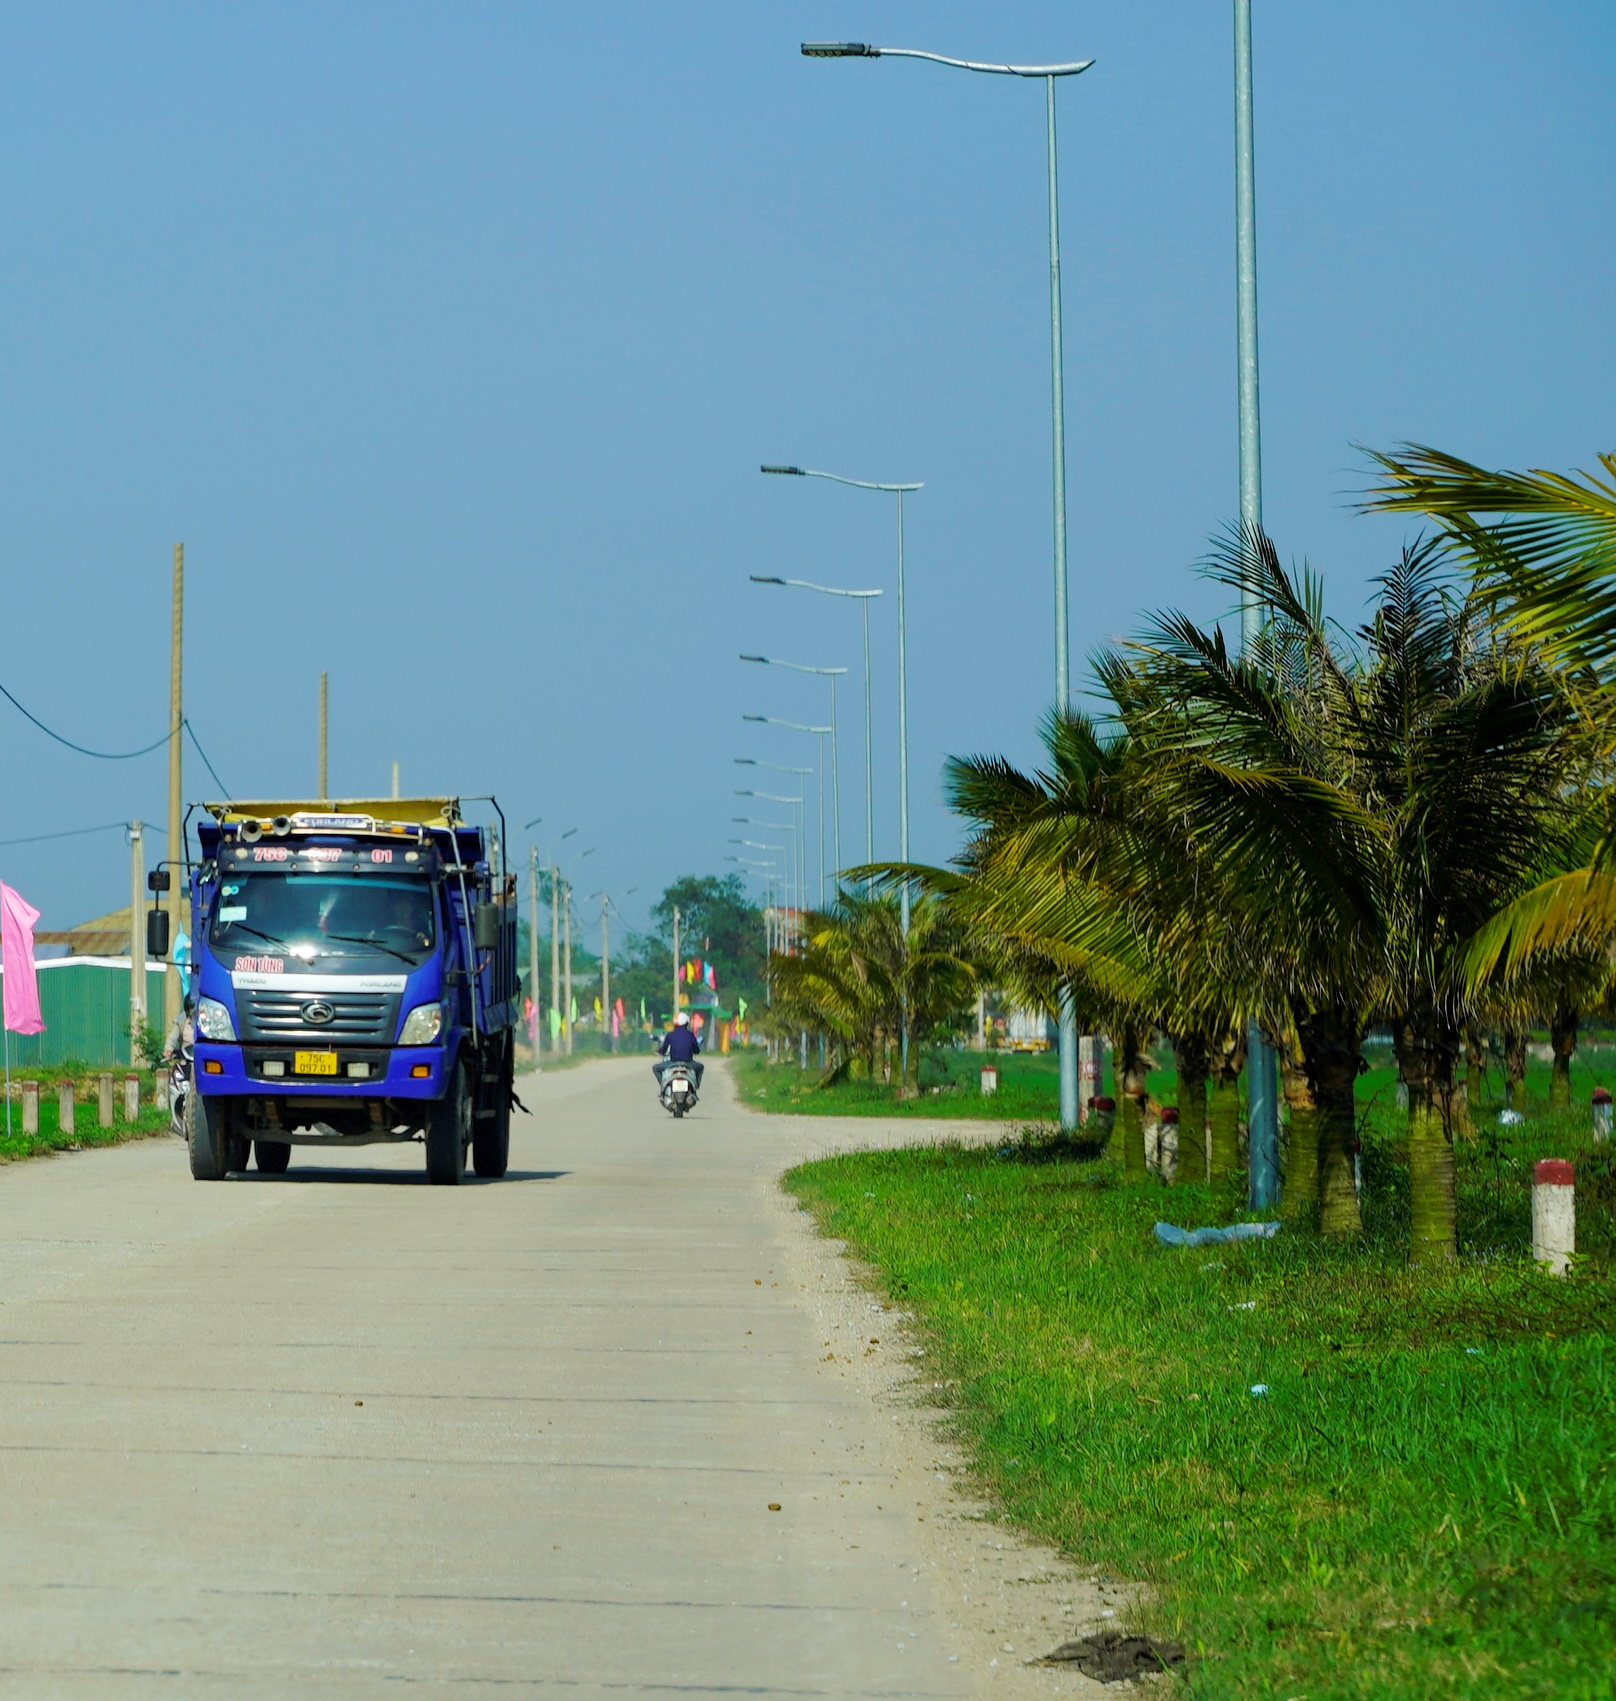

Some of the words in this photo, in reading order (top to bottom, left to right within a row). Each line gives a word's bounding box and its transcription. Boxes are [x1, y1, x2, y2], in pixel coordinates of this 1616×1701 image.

[253, 847, 287, 862] 75C
[371, 849, 393, 863] 01
[307, 1053, 325, 1063] 75C
